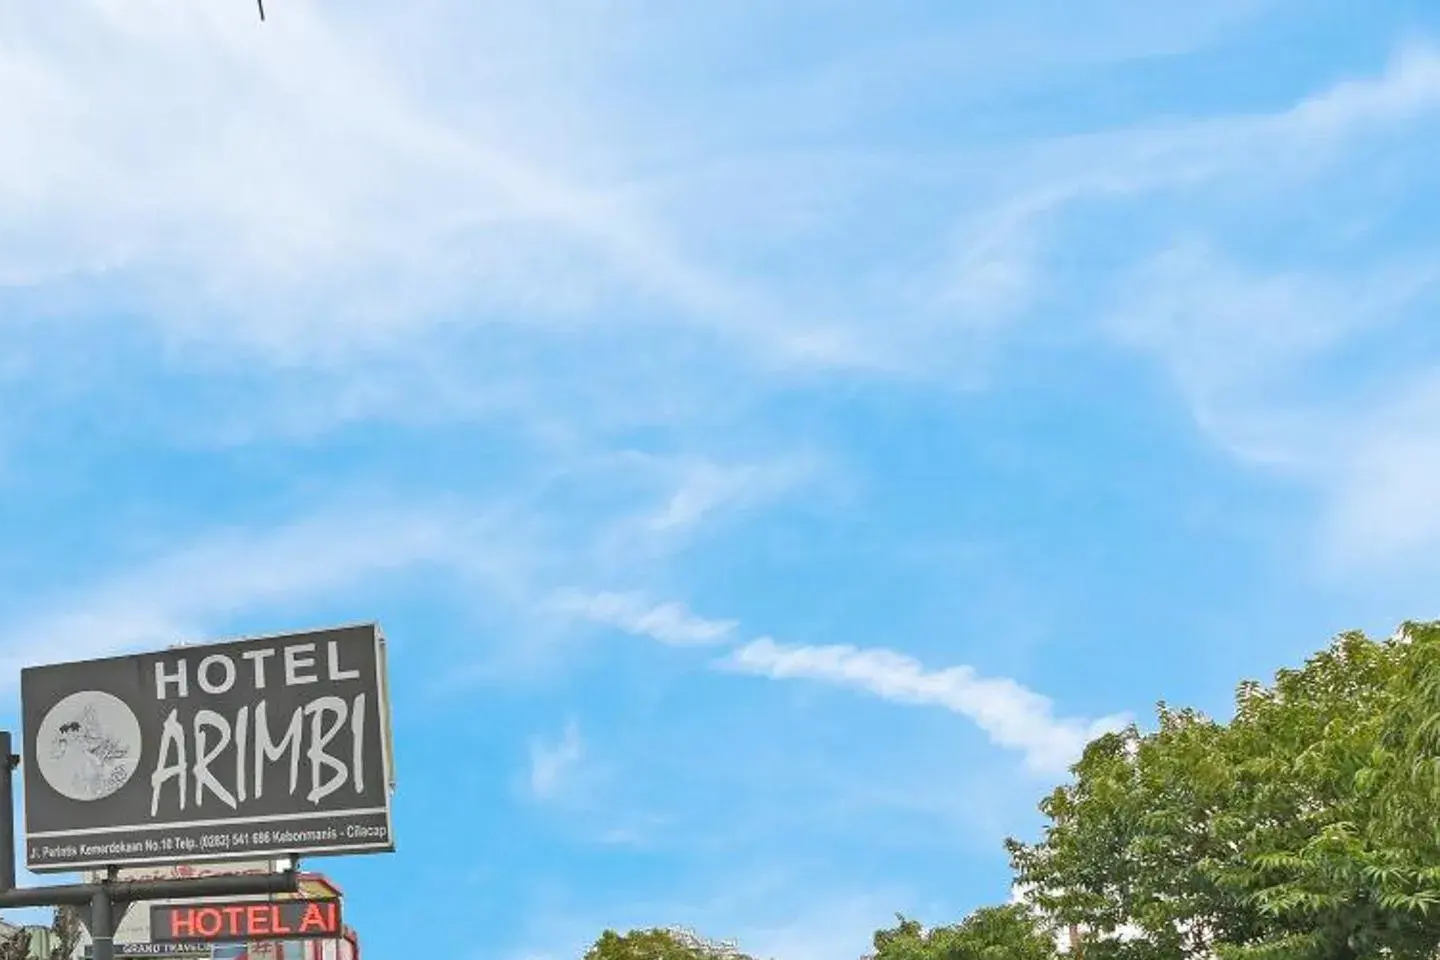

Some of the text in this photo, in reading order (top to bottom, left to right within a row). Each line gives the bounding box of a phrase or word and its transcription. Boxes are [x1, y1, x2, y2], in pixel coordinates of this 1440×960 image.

[155, 640, 360, 699] HOTEL
[151, 692, 366, 818] ARIMBI
[346, 823, 387, 840] Cilacap
[171, 905, 291, 938] HOTEL
